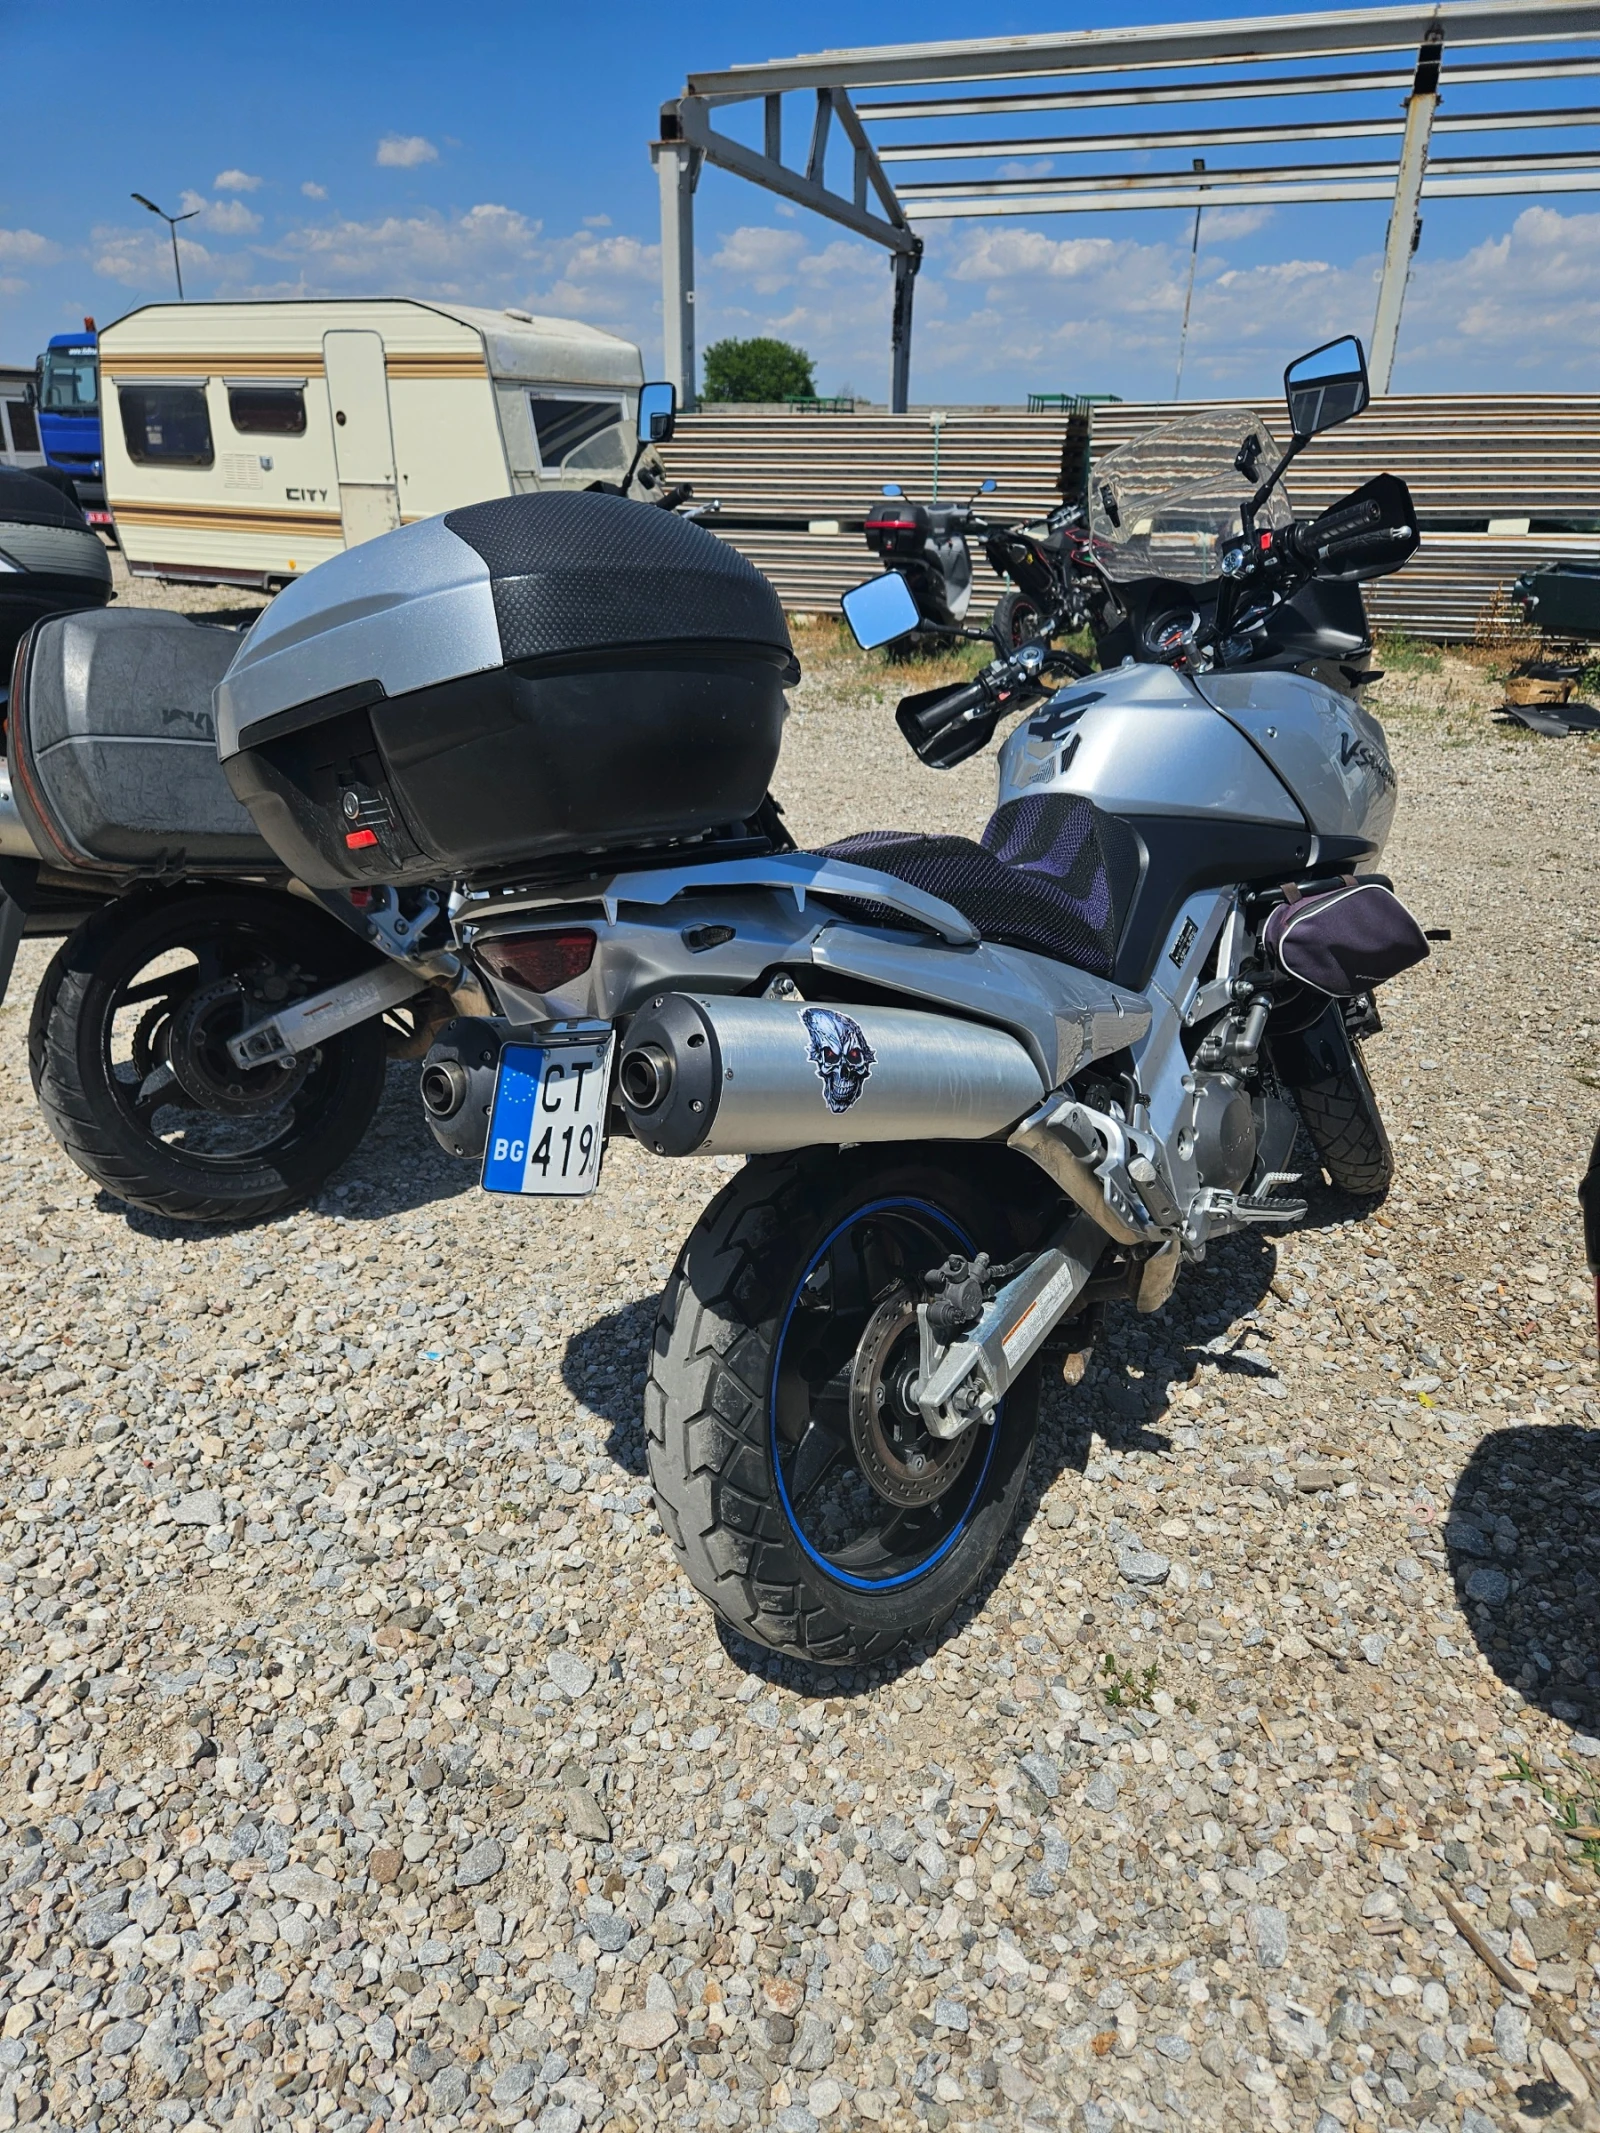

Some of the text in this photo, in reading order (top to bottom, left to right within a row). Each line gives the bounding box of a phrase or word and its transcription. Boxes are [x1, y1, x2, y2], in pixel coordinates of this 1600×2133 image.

[285, 487, 328, 502] CITY
[541, 1061, 604, 1113] CT
[493, 1138, 525, 1162] BG
[531, 1124, 598, 1177] 419
